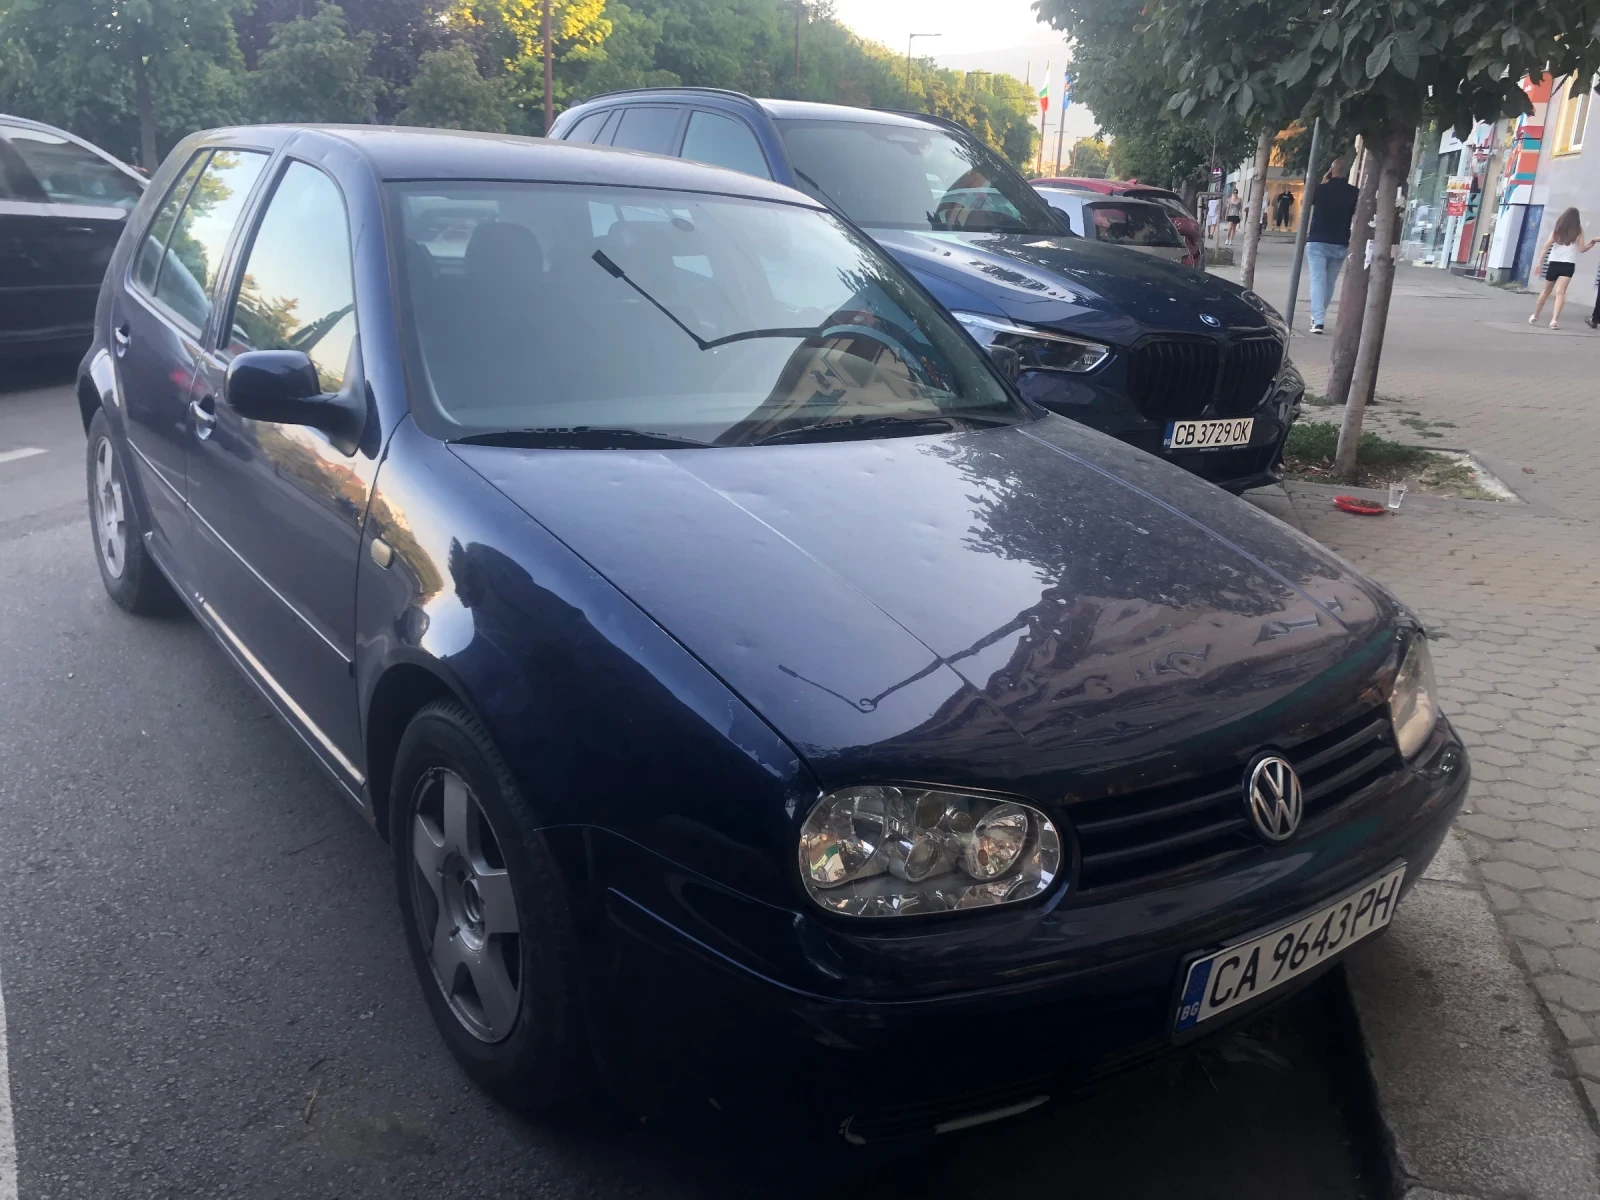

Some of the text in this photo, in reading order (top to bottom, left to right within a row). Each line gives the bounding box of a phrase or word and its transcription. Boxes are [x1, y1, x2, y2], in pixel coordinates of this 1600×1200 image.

[1174, 421, 1250, 445] CB 3729 OK
[1209, 946, 1259, 1008] CA
[1180, 1001, 1200, 1020] BG
